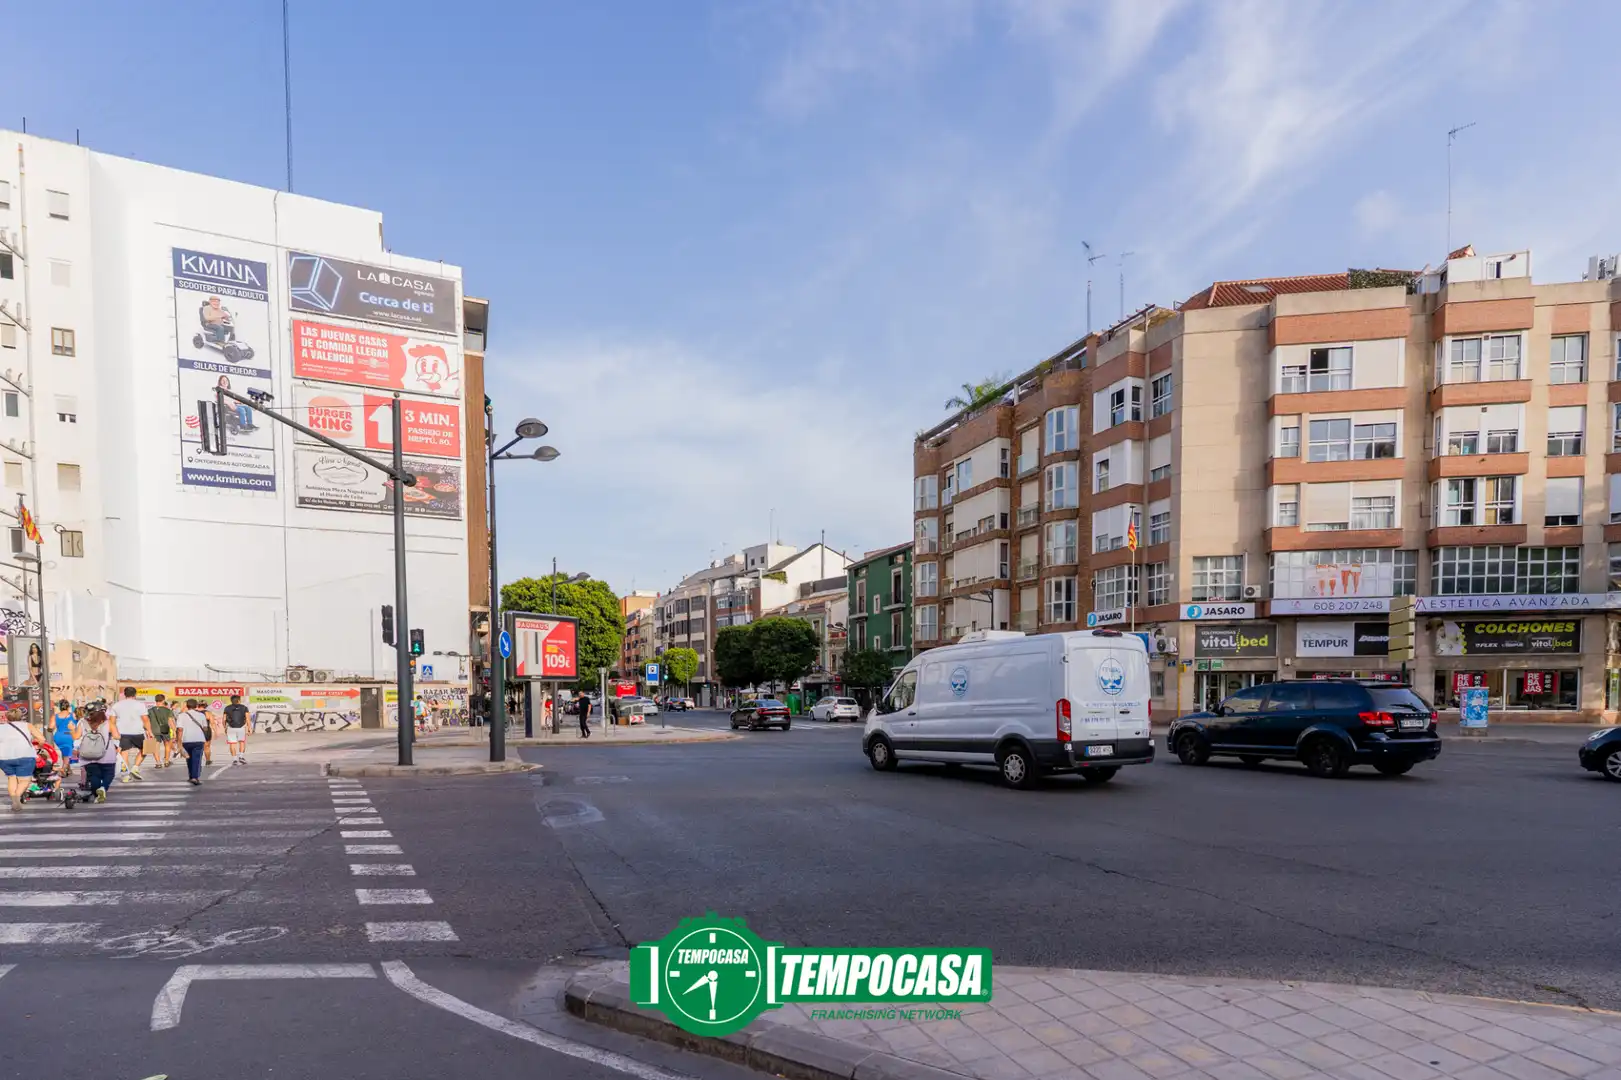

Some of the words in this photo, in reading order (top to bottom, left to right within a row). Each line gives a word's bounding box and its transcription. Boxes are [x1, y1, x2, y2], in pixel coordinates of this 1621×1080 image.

[181, 253, 260, 286] KMINA
[357, 270, 377, 282] LA
[392, 276, 434, 292] CASA
[179, 280, 216, 293] SCOOTERS
[217, 286, 236, 296] PARA
[237, 290, 264, 300] ADULTO
[359, 291, 398, 308] Cerca
[402, 300, 420, 312] de
[423, 302, 434, 314] ti
[300, 326, 318, 337] LAS
[320, 328, 357, 343] NUEVAS
[358, 335, 388, 348] CASAS
[301, 336, 313, 347] DE
[315, 339, 353, 354] COMIDA
[355, 345, 388, 359] LLEGAN
[301, 348, 308, 358] A
[310, 348, 354, 365] VALENCIA
[193, 361, 217, 371] SILLAS
[218, 365, 228, 373] DE
[229, 366, 257, 377] RUEDAS
[308, 407, 353, 420] BURGER
[405, 409, 415, 422] 3
[418, 411, 455, 427] MIN.
[308, 416, 353, 431] KING
[442, 430, 453, 438] DE
[187, 472, 272, 487] www.kmina.com
[1313, 602, 1335, 611] 608
[1338, 601, 1360, 611] 207
[1362, 600, 1383, 610] 248
[1509, 597, 1590, 607] AVANZADA
[1098, 612, 1122, 622] JASARO
[1204, 607, 1245, 615] JASARO
[1474, 622, 1575, 634] COLCHONES
[1201, 635, 1237, 648] vital
[1240, 634, 1269, 647] bed
[1302, 639, 1348, 648] TEMPUR
